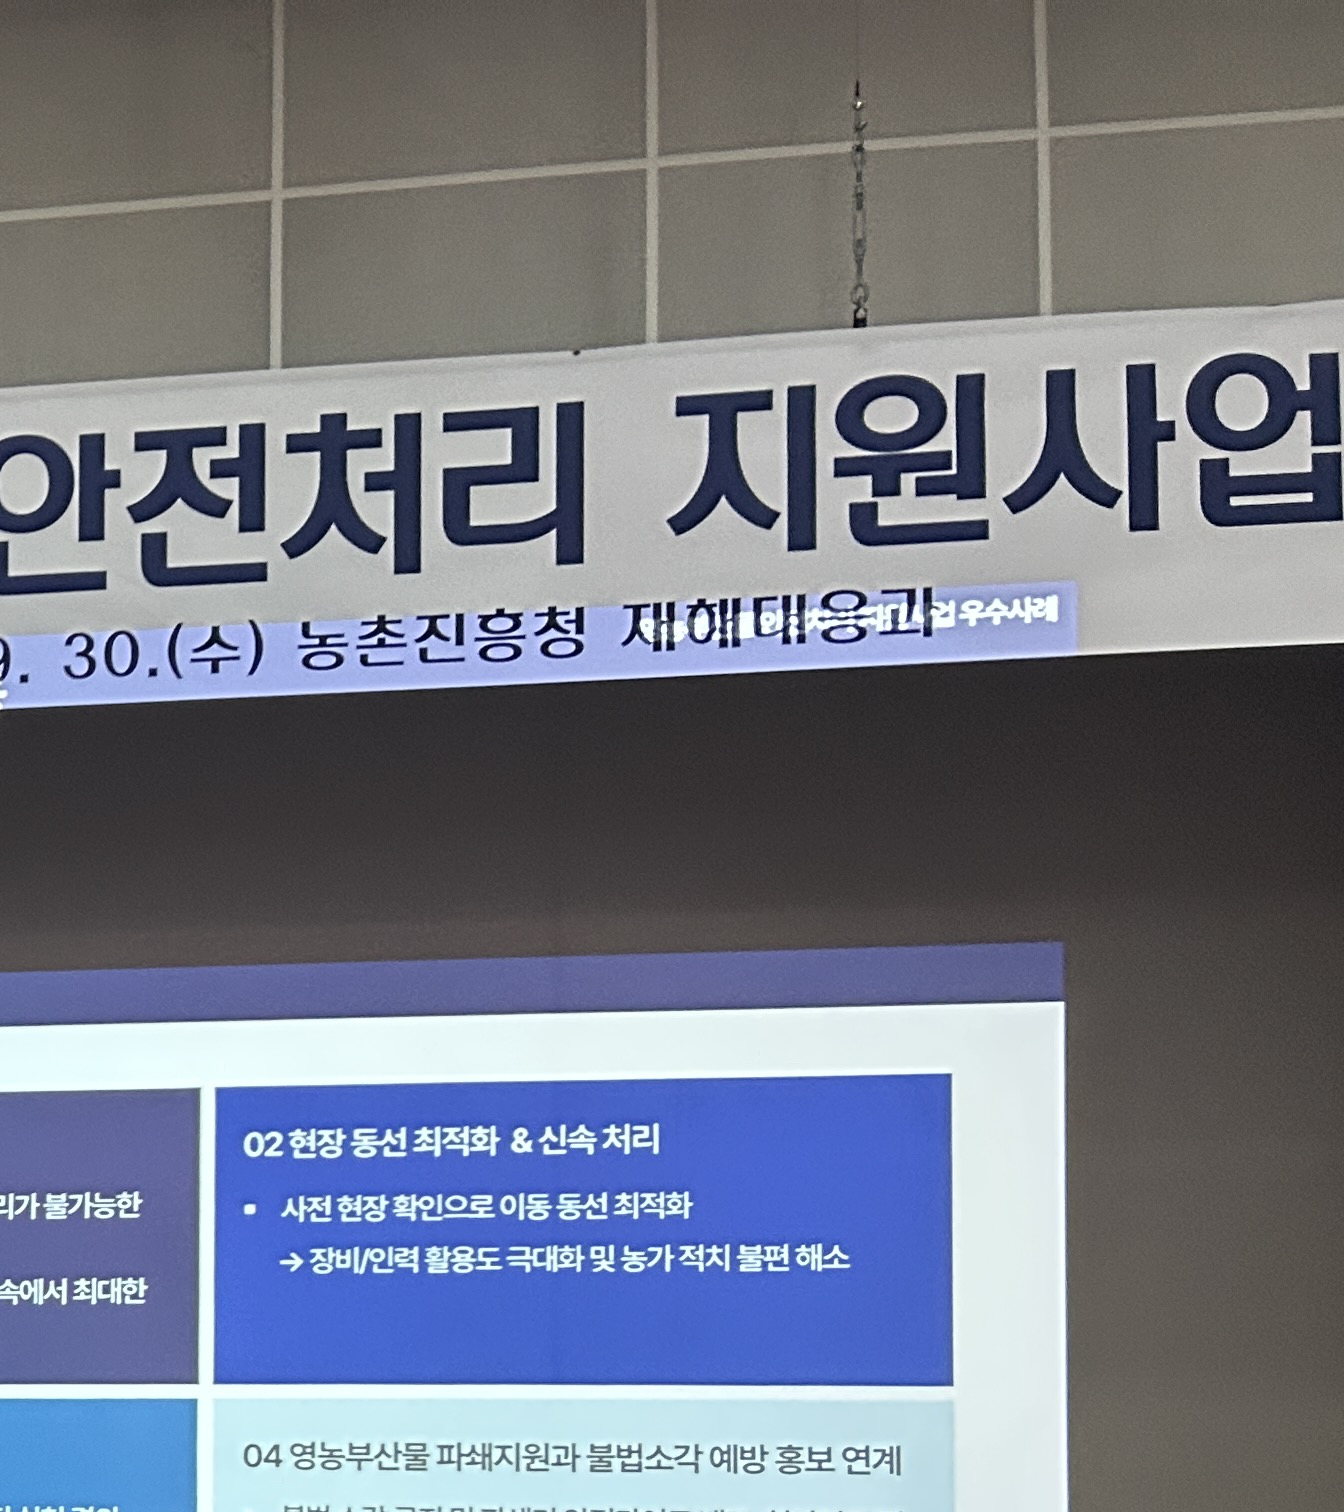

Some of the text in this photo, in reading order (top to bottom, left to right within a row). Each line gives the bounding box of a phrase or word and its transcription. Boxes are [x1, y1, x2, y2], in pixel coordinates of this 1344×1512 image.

[666, 353, 1344, 551] 지원사업
[958, 594, 1059, 627] 우수사례
[63, 619, 264, 679] 30.(수)
[297, 605, 586, 670] 농촌진흥청
[622, 586, 936, 652] 재해대응과
[244, 1123, 659, 1158] 02 현장 동선 최적화 & 신속 처리
[43, 1191, 143, 1219] 불가능한
[281, 1191, 693, 1222] 사전 현장 확인으로 이동 동선 최적화
[310, 1243, 850, 1274] 장비/인력 활용도 극대화 및 농가 적치 불편 해소
[73, 1277, 148, 1304] 최대한
[244, 1442, 901, 1476] 04 영농부산물 파쇄지원과 불법소각 예방 홍보 연계
